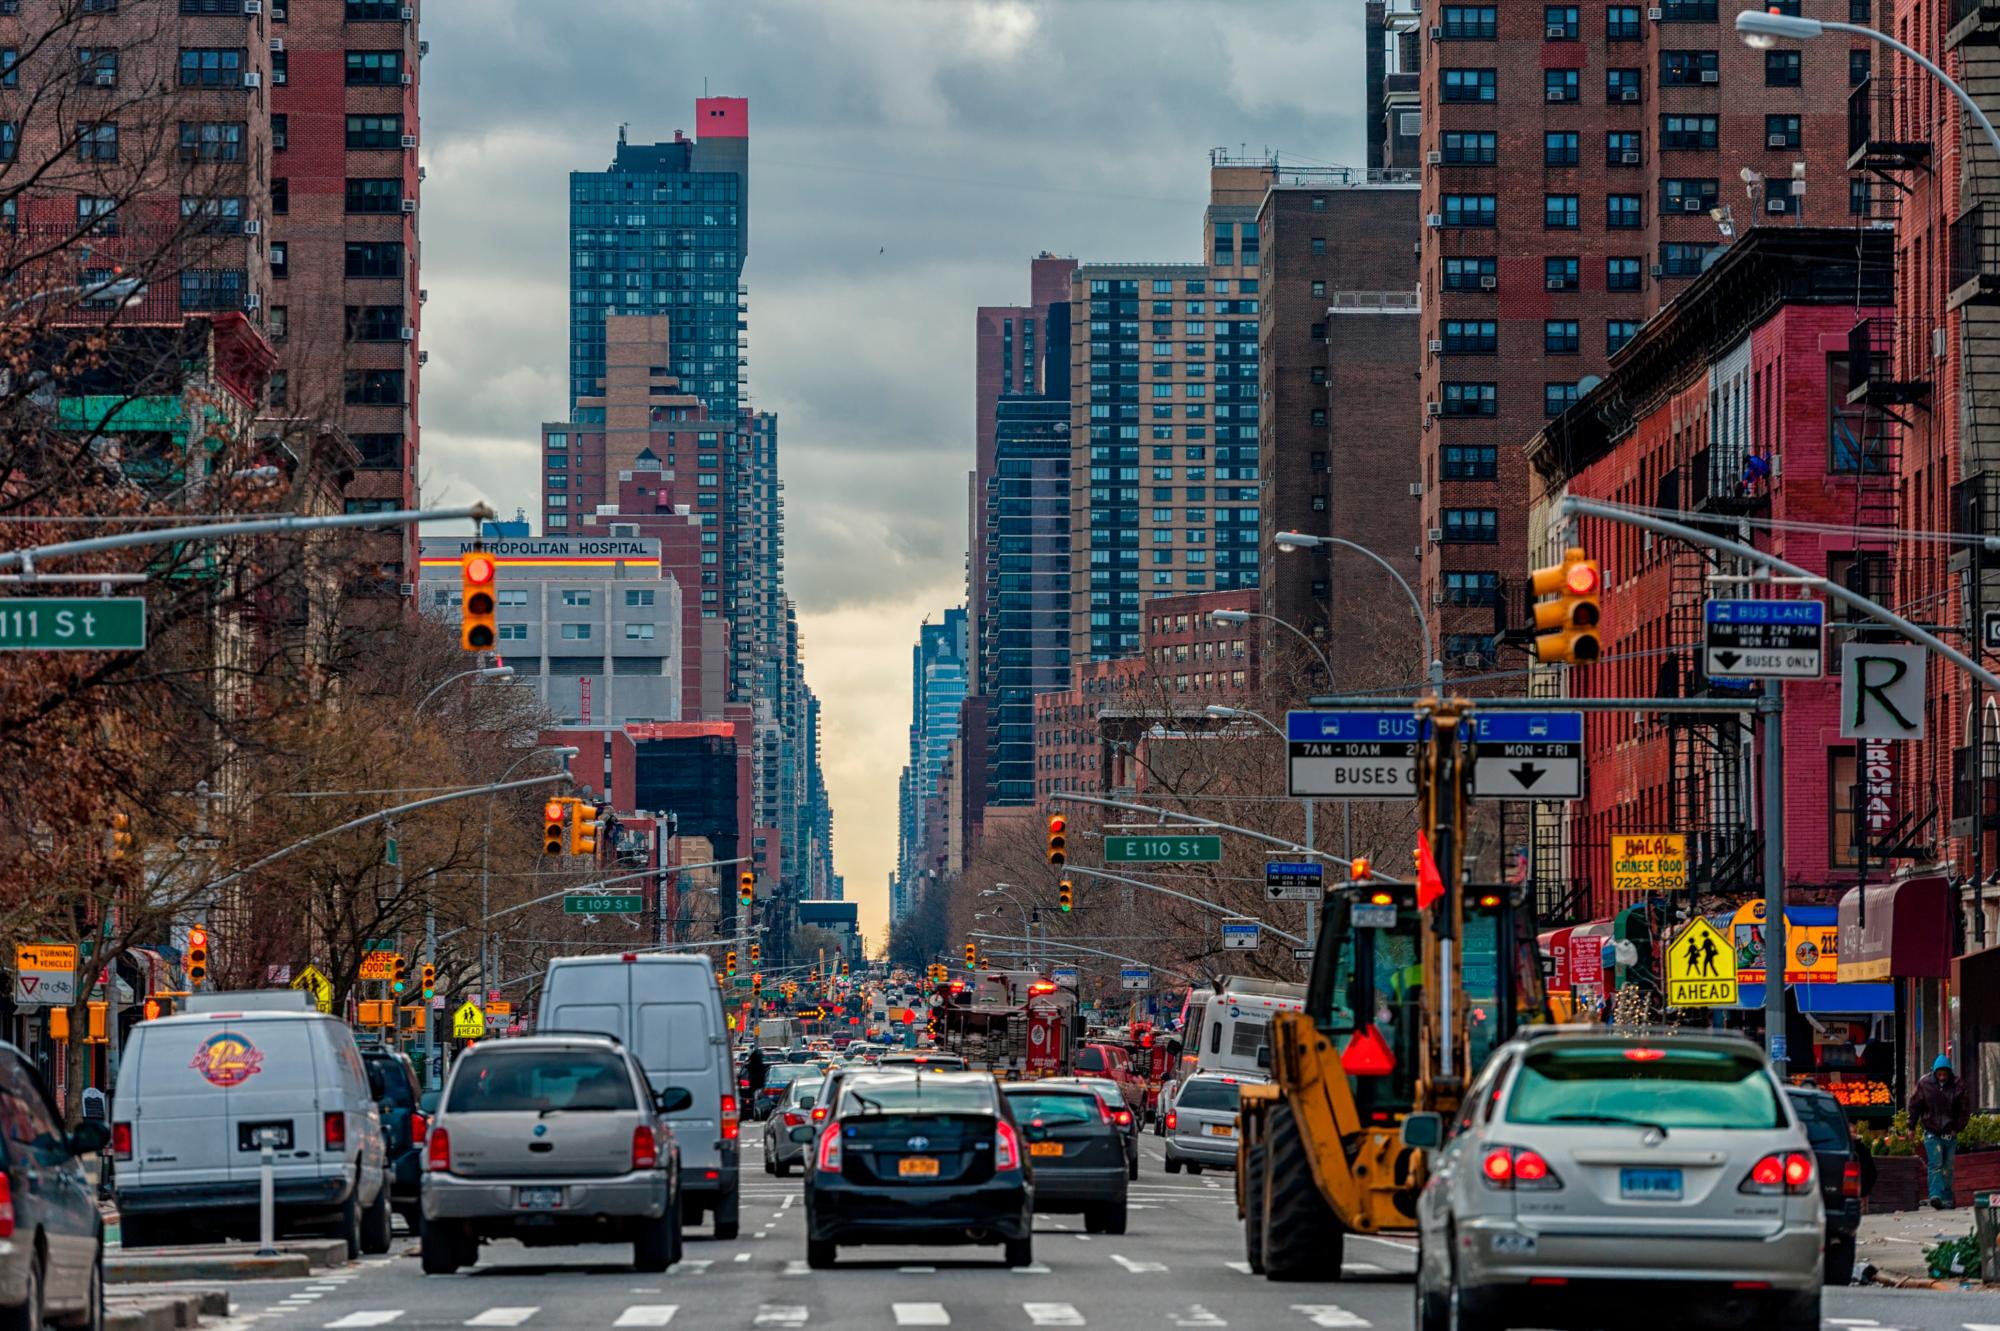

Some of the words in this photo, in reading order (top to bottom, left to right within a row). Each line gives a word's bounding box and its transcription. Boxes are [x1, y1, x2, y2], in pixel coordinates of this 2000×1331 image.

[579, 542, 648, 554] HOSPITAL
[1739, 607, 1768, 618] BUS
[1774, 608, 1813, 619] LANE
[55, 610, 96, 637] St
[1739, 637, 1762, 646] MON
[1772, 637, 1789, 647] FRI
[1745, 655, 1782, 667] BUSES
[1787, 655, 1816, 668] ONLY
[1854, 656, 1918, 730] R
[1378, 719, 1417, 736] BUS
[1303, 744, 1332, 756] 7AM
[1346, 744, 1381, 756] 10AM
[1504, 744, 1534, 756] MON
[1546, 744, 1568, 756] FRI
[1335, 767, 1398, 784] BUSES
[1126, 842, 1137, 856] E
[1144, 842, 1171, 856] 110
[1179, 842, 1200, 856] St
[1625, 838, 1671, 856] HALAL
[1615, 861, 1655, 873] CHINESE
[1658, 860, 1682, 872] FOOD
[1615, 875, 1683, 889] 722-5250
[576, 900, 584, 910] E
[589, 900, 610, 910] 109
[616, 900, 629, 910] St
[361, 962, 385, 972] FOOD
[1676, 983, 1730, 1000] AHEAD
